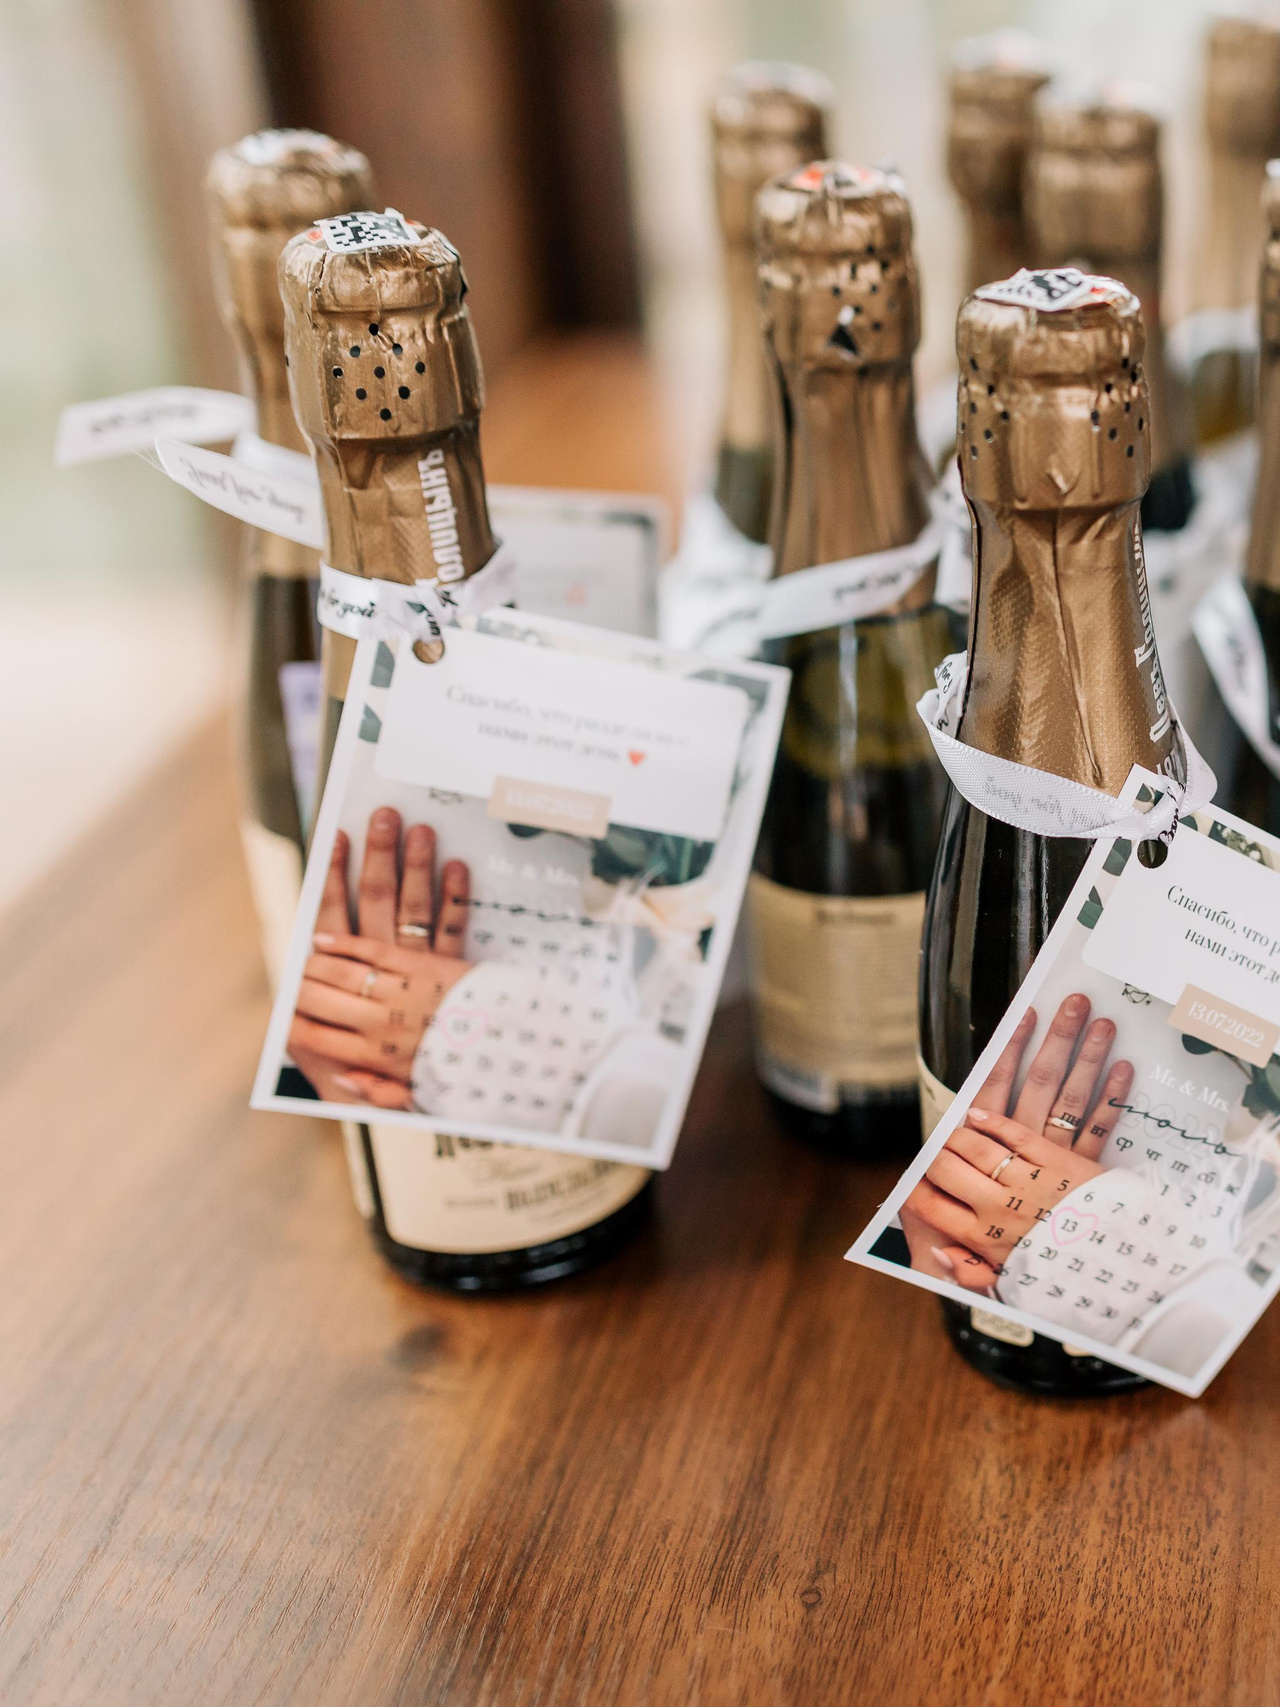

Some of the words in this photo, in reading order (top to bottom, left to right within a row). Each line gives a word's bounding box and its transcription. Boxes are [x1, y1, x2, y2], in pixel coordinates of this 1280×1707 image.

[415, 448, 466, 587] олицынъ
[1166, 884, 1238, 935] Спасибо,
[1242, 922, 1270, 949] что
[1184, 928, 1229, 958] нами
[1228, 949, 1267, 978] этот
[1149, 1063, 1177, 1090] Mr.
[1179, 1079, 1196, 1097] &
[1196, 1085, 1231, 1114] Mrs.
[1090, 1124, 1109, 1138] вт
[1115, 1136, 1134, 1152] ср
[1146, 1148, 1163, 1162] чт
[1170, 1159, 1191, 1175] пт
[1196, 1170, 1218, 1186] сб
[1030, 1168, 1041, 1180] 4
[1057, 1179, 1070, 1192] 5
[1083, 1191, 1096, 1203] 6
[1111, 1201, 1125, 1214] 7
[1138, 1213, 1152, 1226] 8
[1165, 1224, 1178, 1237] 9
[1189, 1234, 1208, 1249] 10
[1160, 1184, 1170, 1197] 1
[1184, 1194, 1198, 1208] 2
[1210, 1205, 1223, 1219] 3
[985, 1224, 1005, 1240] 18
[1013, 1236, 1033, 1249] 19
[1038, 1246, 1059, 1260] 20
[1066, 1257, 1086, 1273] 21
[1093, 1268, 1115, 1284] 22
[1120, 1279, 1141, 1294] 23
[1005, 1196, 1024, 1212] 11
[1033, 1208, 1053, 1223] 12
[1060, 1218, 1079, 1233] 13
[1089, 1230, 1107, 1245] 14
[1116, 1241, 1135, 1256] 15
[1142, 1252, 1160, 1267] 16
[1168, 1263, 1188, 1276] 17
[1018, 1273, 1039, 1287] 27
[1046, 1284, 1067, 1299] 28
